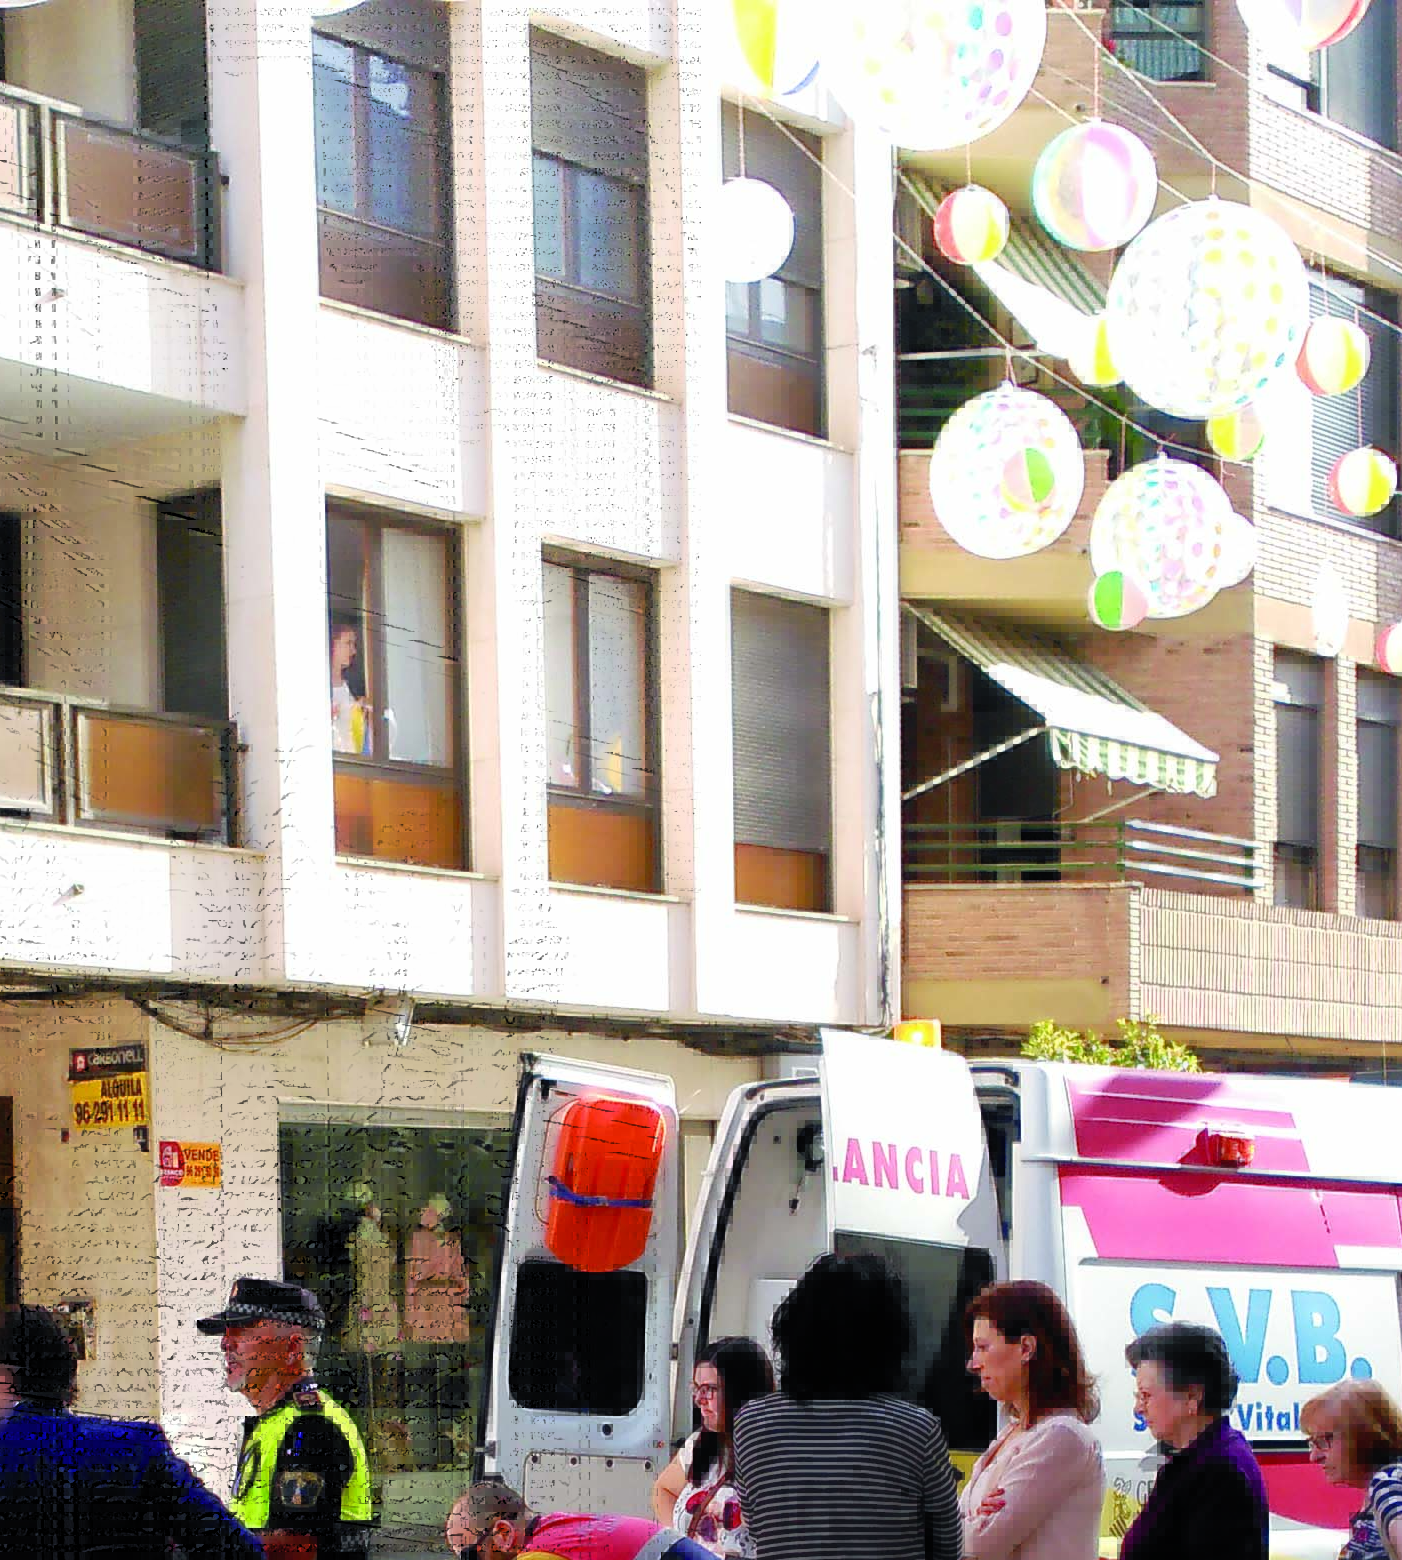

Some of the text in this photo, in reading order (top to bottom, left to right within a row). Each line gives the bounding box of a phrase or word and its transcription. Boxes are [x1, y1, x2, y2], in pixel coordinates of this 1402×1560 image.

[101, 1077, 142, 1099] ALQUILA
[74, 1098, 145, 1125] 96 291 11 11
[184, 1148, 219, 1162] VENDE
[833, 1137, 970, 1201] ANCIA
[1236, 1401, 1300, 1432] Vital
